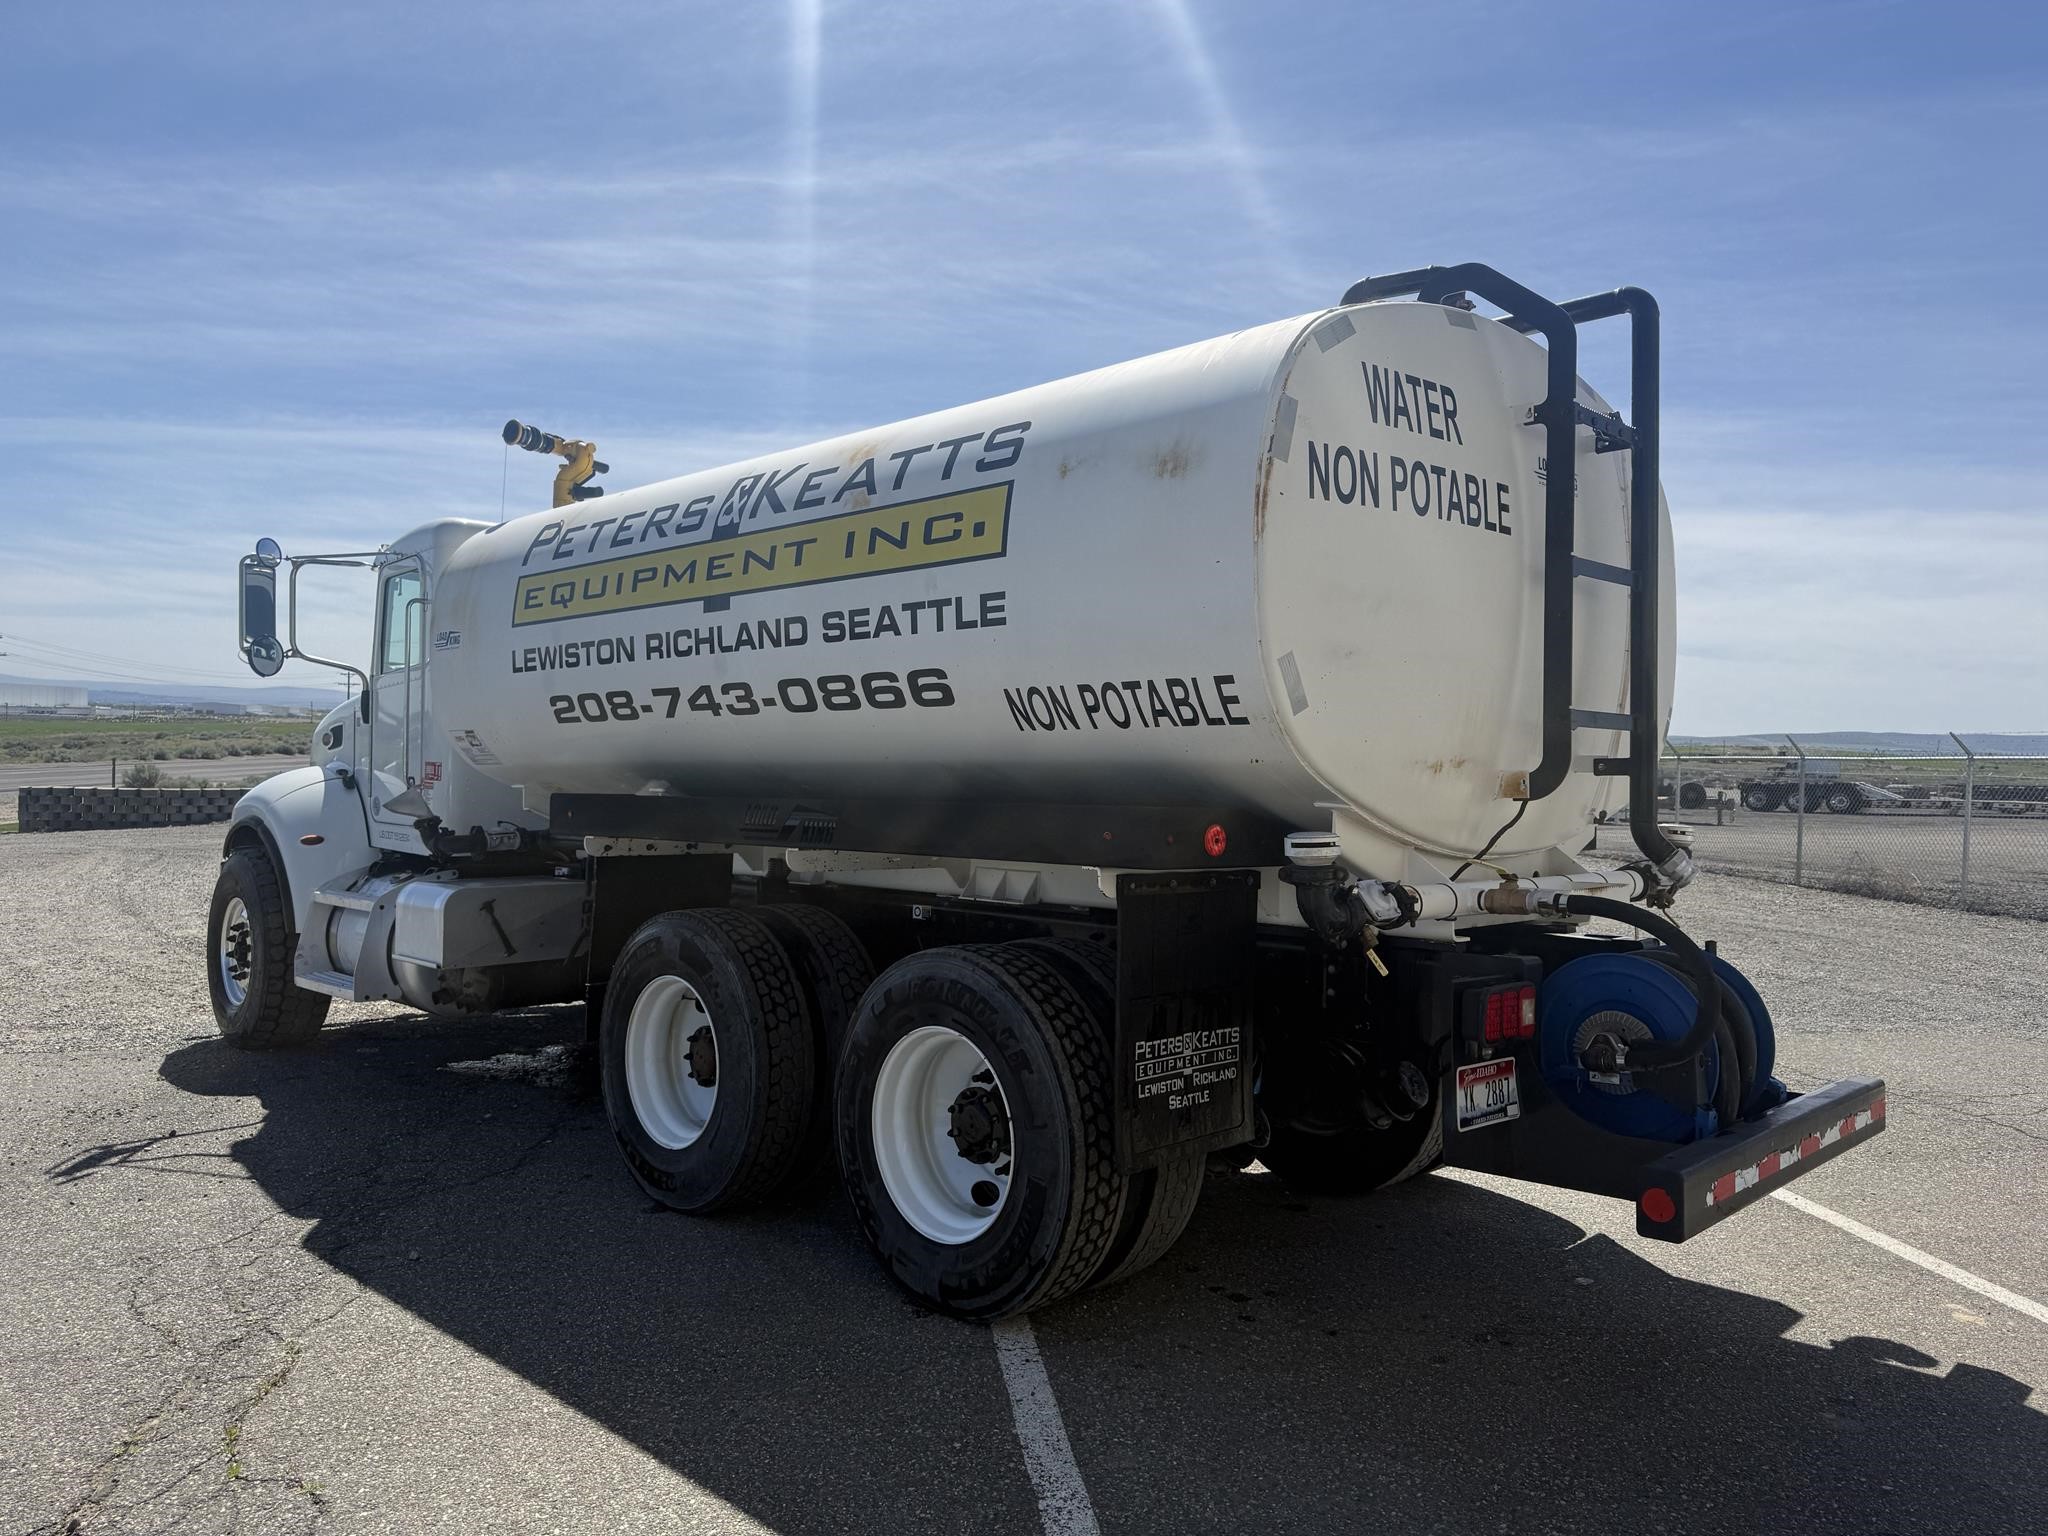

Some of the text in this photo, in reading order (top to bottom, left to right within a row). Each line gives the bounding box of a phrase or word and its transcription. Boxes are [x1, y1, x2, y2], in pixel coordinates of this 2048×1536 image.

[1361, 361, 1464, 446] WATER
[1307, 440, 1512, 536] NON POTABLE
[524, 511, 987, 609] EQUIPMENT INC.
[511, 591, 1007, 674] LEWISTON RICHLAND SEATTLE
[549, 667, 956, 724] 208-743-0866
[1003, 674, 1250, 732] NON POTABLE
[1138, 1067, 1237, 1099] LEWISTON RICHLAND
[1139, 1049, 1236, 1077] EQUIPMENT INC.
[1476, 1064, 1497, 1078] IDAHO
[1168, 1090, 1211, 1110] SEATTLE
[1463, 1077, 1510, 1113] YK 2887
